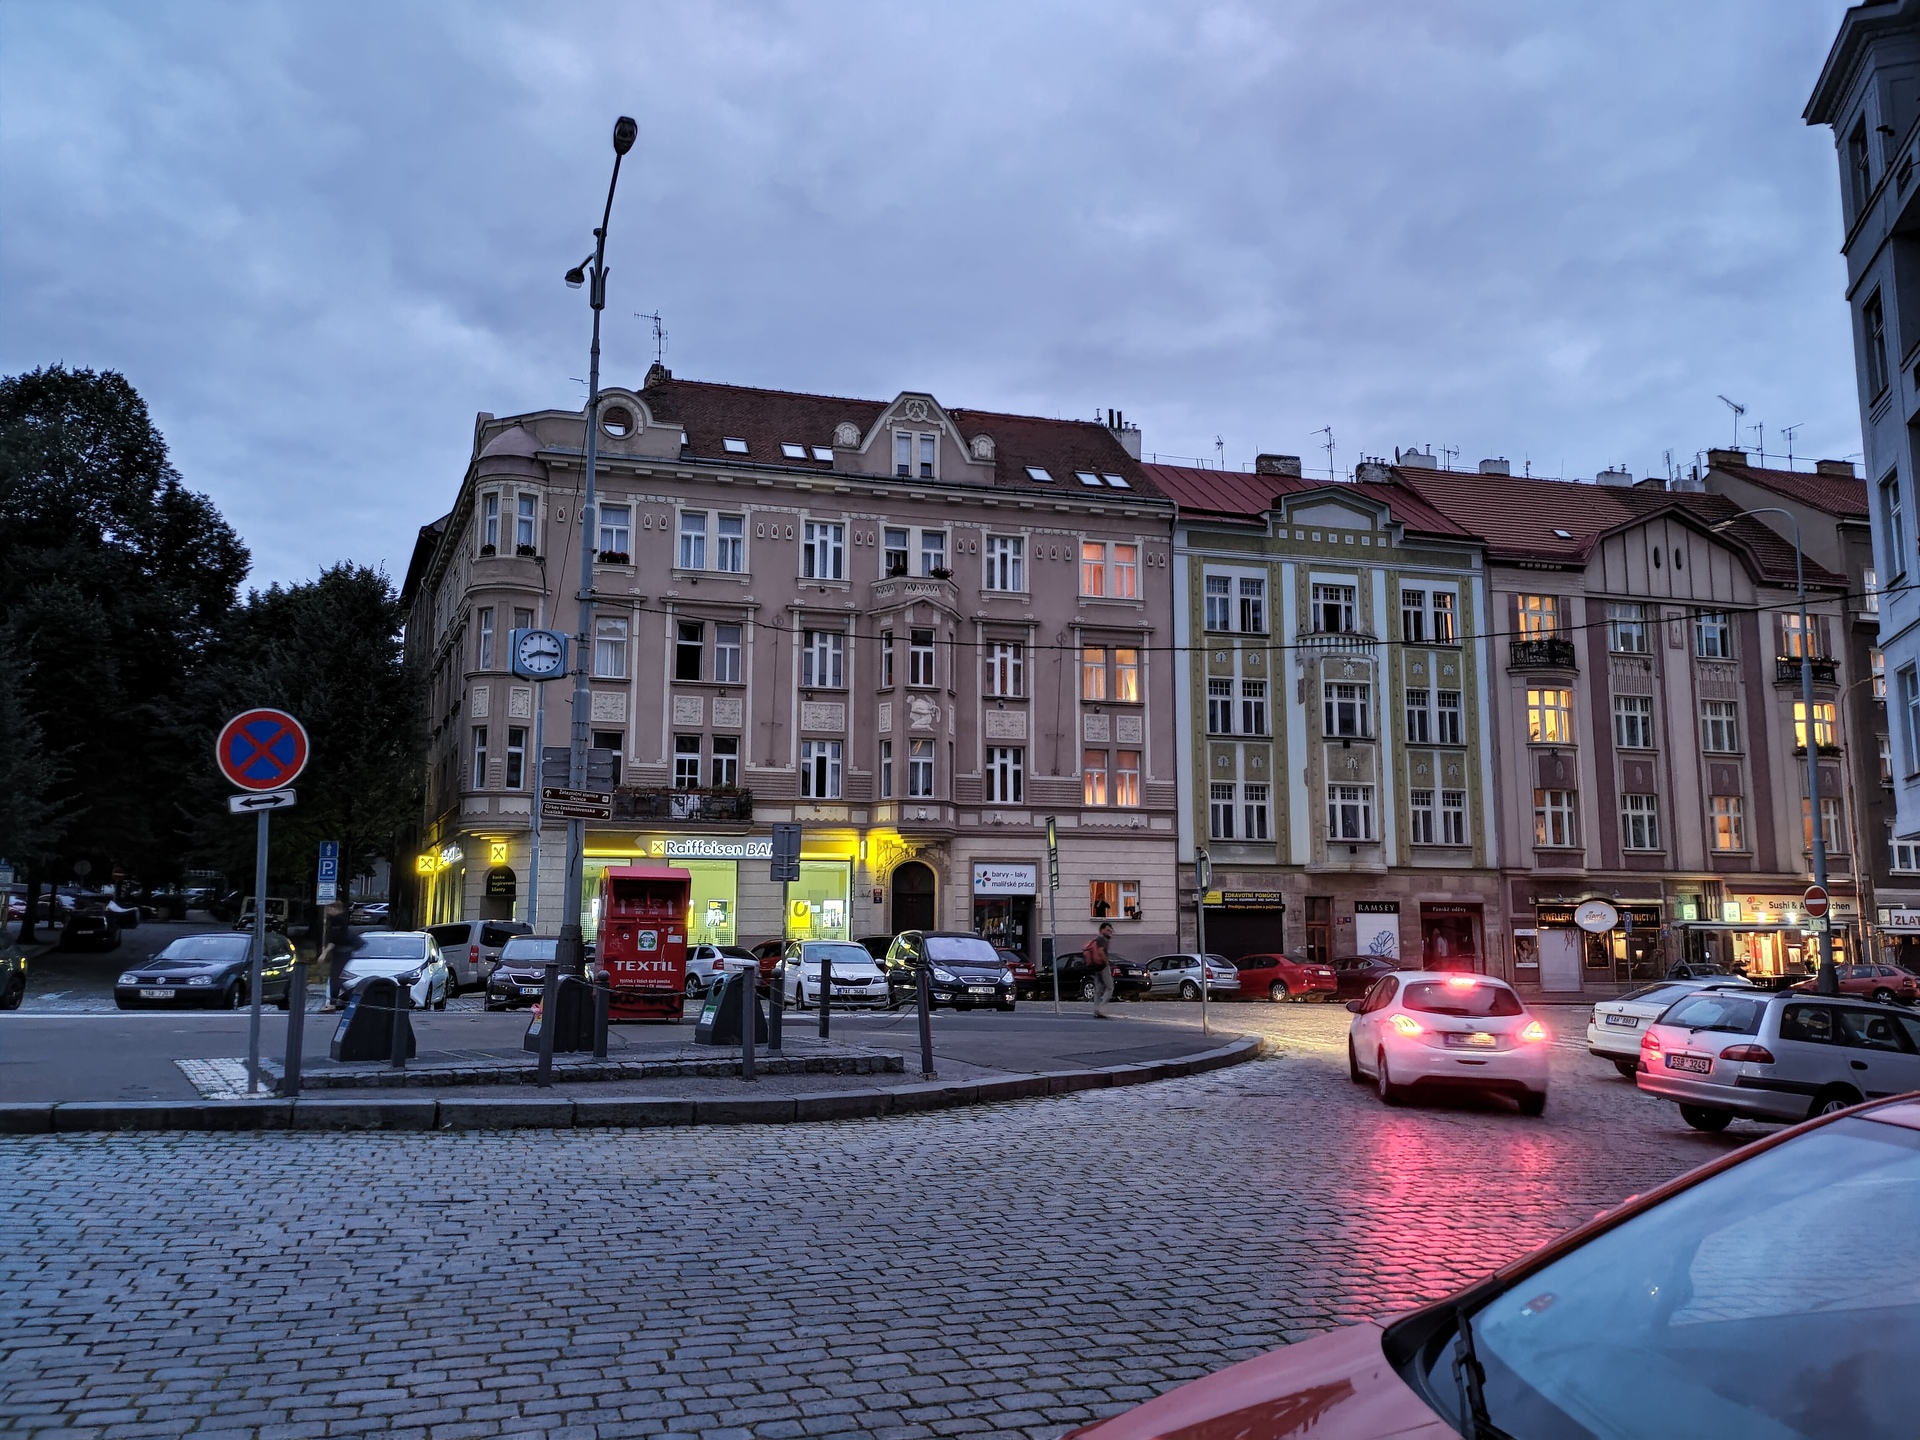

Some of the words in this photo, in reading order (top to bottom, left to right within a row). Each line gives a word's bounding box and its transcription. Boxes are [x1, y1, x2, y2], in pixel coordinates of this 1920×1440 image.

[666, 840, 743, 855] Raiffeisen
[746, 842, 773, 857] BA
[991, 871, 1010, 879] barvy
[1014, 871, 1028, 879] laky
[1358, 903, 1395, 911] RAMSEY
[1769, 901, 1790, 909] Sushi
[1791, 901, 1798, 909] &
[1538, 913, 1573, 921] JEWELLERY
[1619, 911, 1656, 921] ZLTNICTVÍ
[614, 960, 678, 971] TEXTIL
[1672, 1056, 1685, 1067] 5SB
[1689, 1058, 1707, 1070] 3249
